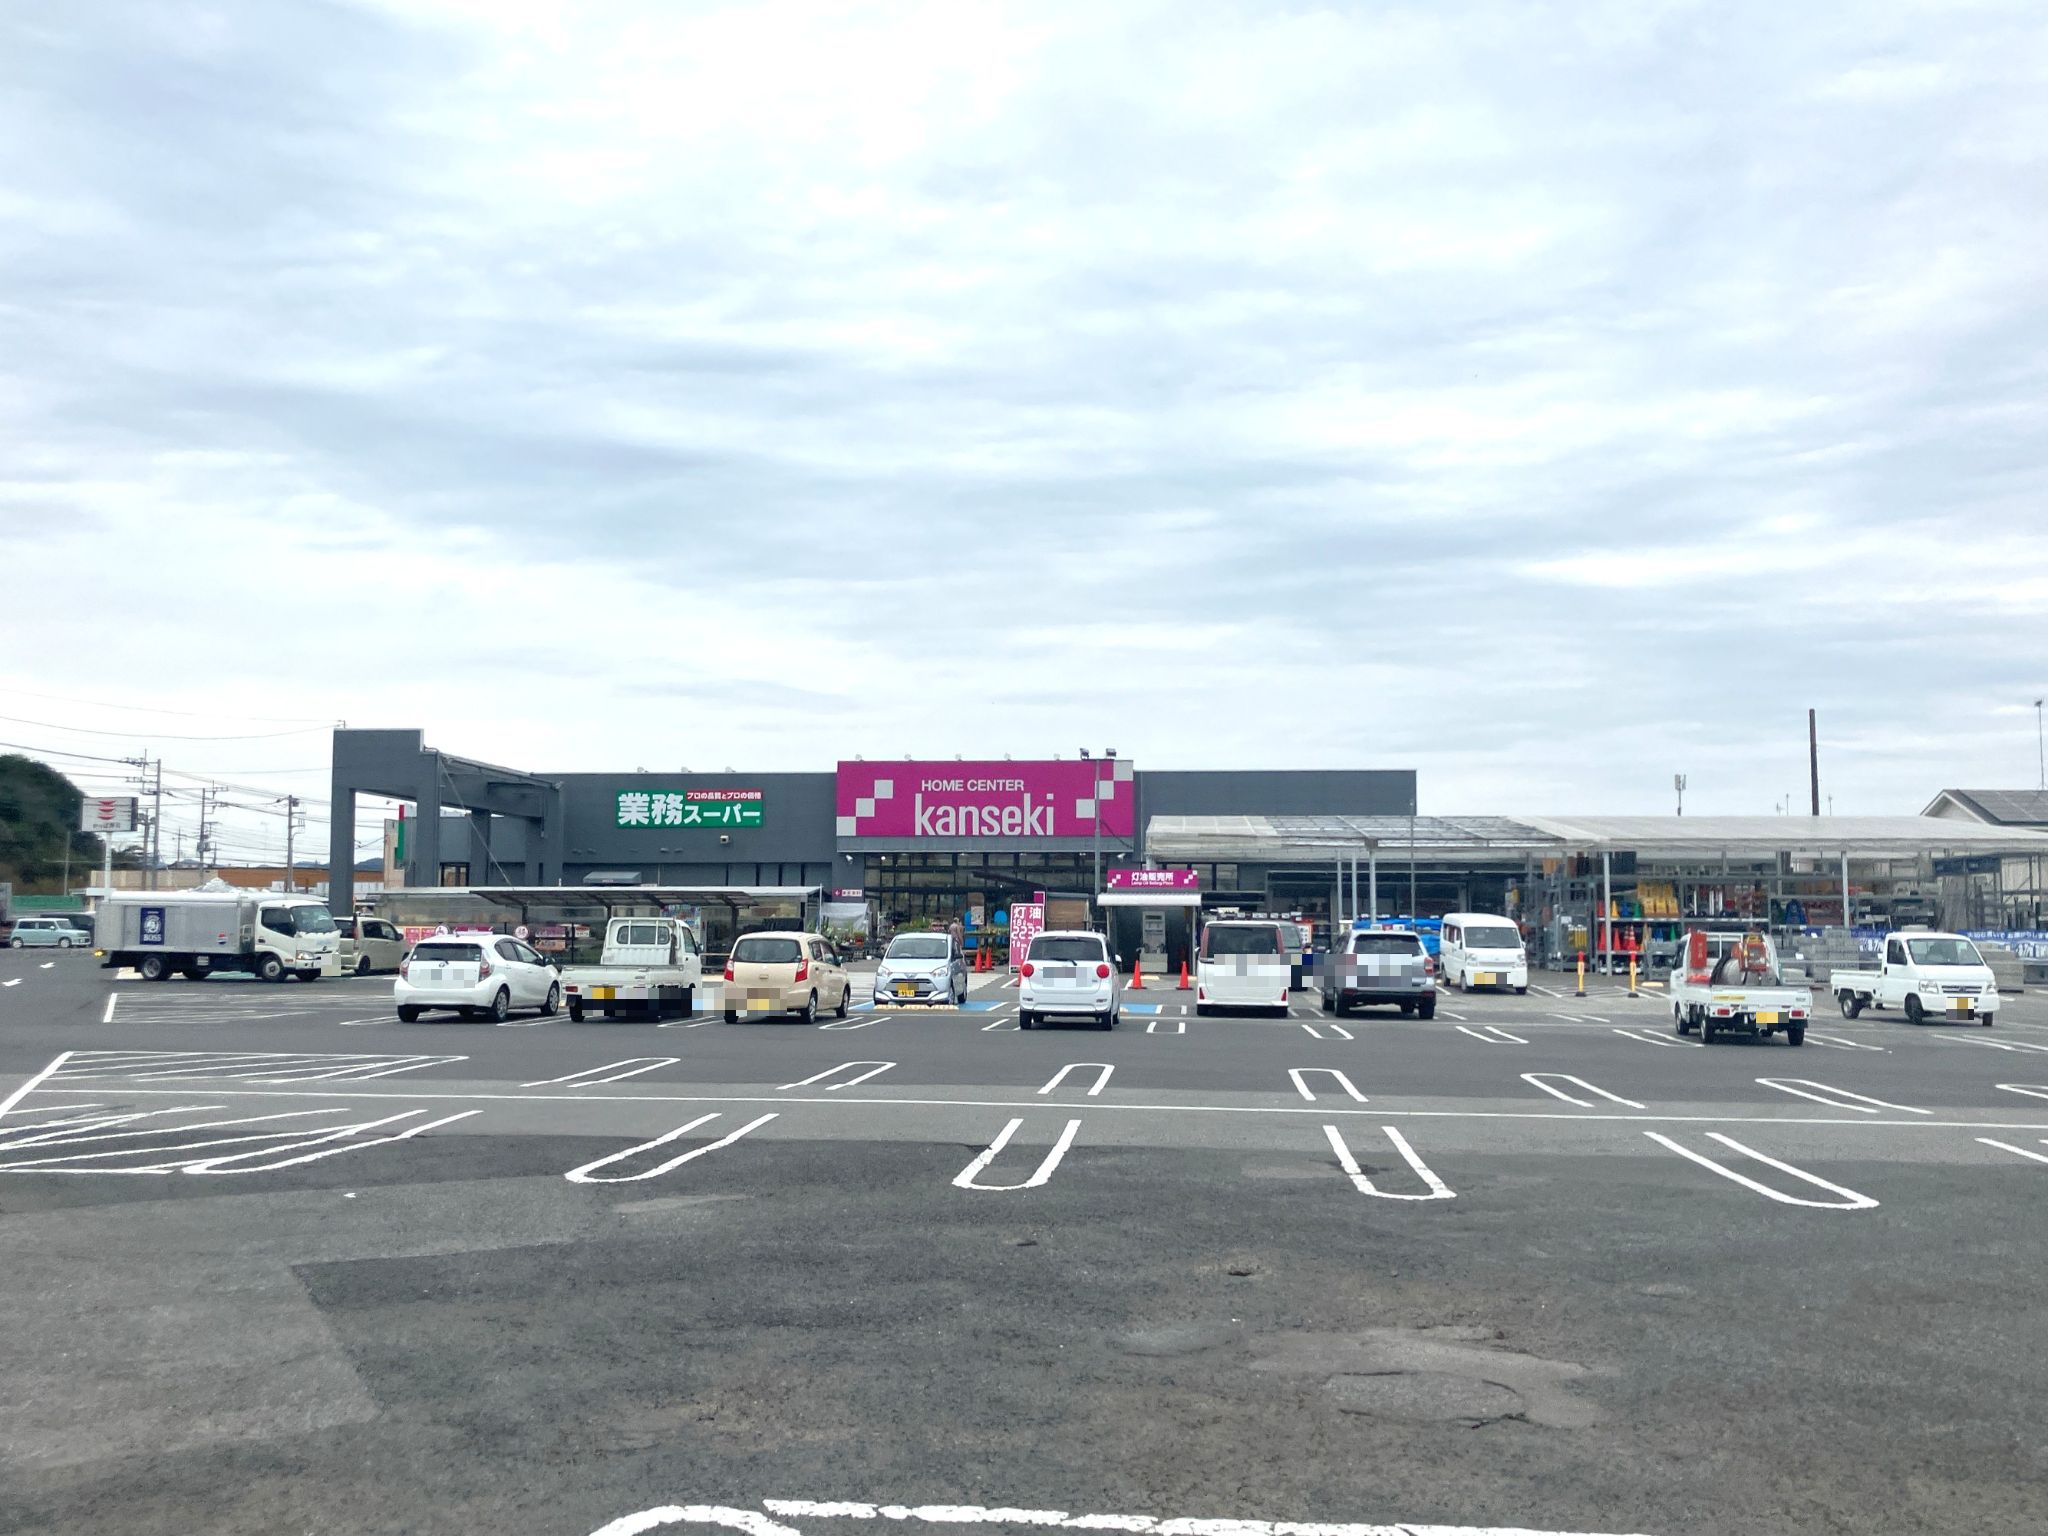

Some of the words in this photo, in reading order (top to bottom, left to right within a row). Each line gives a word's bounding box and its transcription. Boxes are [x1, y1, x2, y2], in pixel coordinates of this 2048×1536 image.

[921, 780, 964, 791] HOME
[967, 780, 1024, 791] CENTER
[618, 793, 760, 825] 業務スーパー
[915, 793, 1054, 836] kanseki
[1013, 907, 1041, 919] 灯油
[143, 934, 161, 942] BOSS
